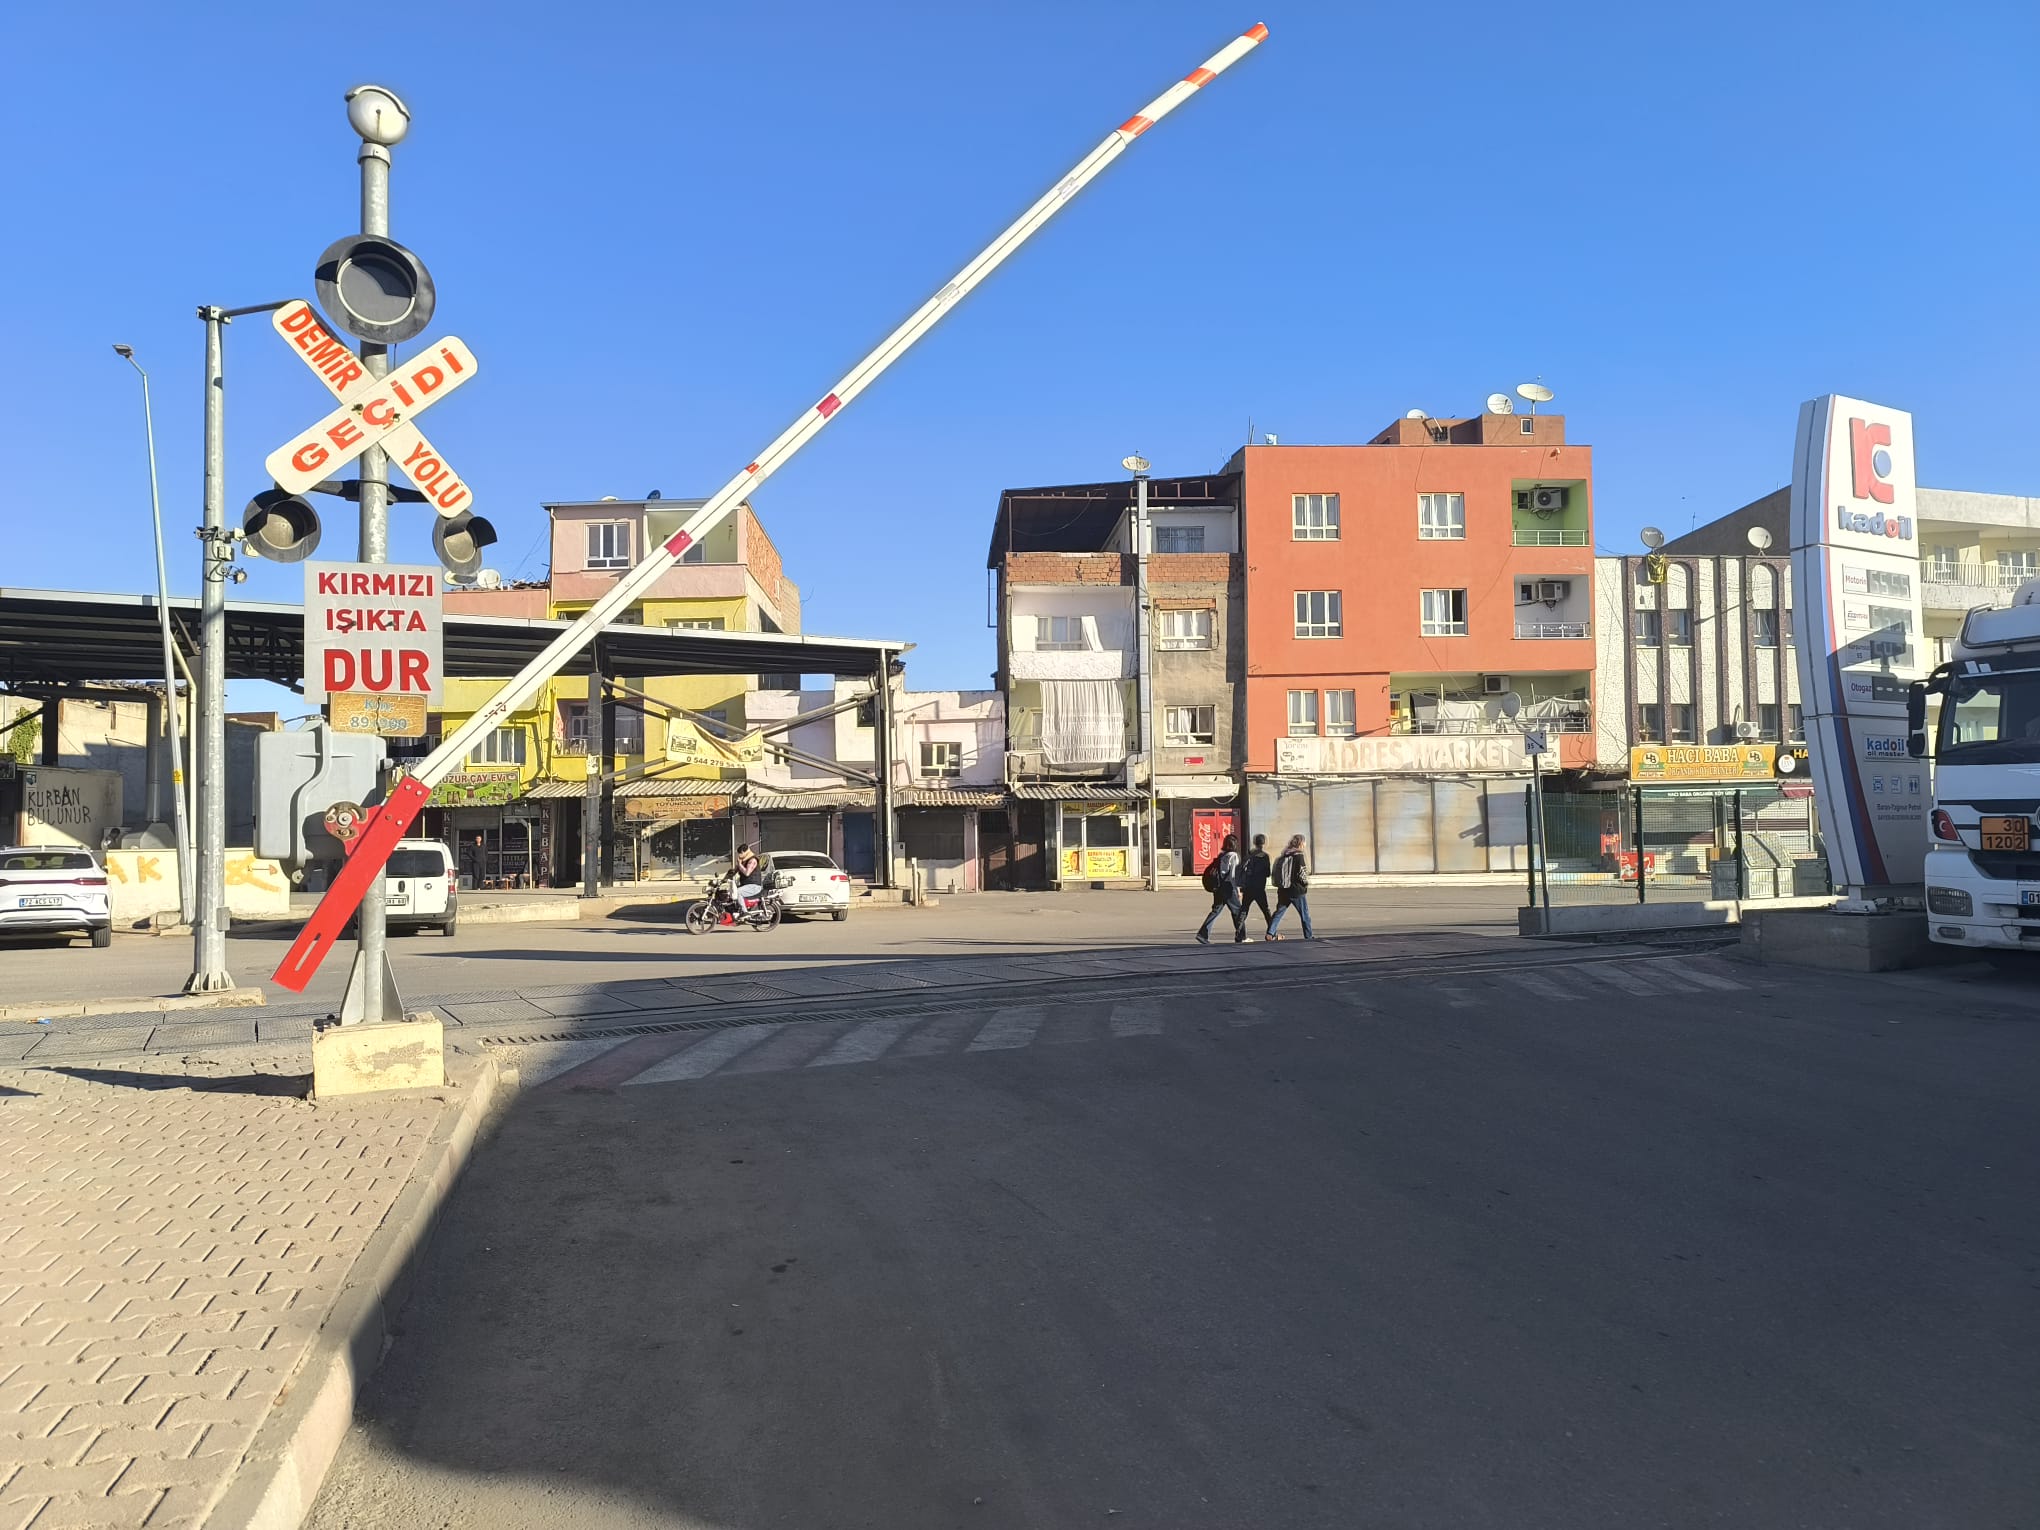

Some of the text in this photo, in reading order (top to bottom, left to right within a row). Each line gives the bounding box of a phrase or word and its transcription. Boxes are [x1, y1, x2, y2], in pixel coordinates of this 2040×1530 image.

[292, 347, 463, 473] GEÇİDİ
[1837, 505, 1912, 541] kadoil
[318, 572, 433, 597] KIRMIZI
[326, 608, 427, 634] IŞIKTA
[324, 648, 432, 692] DUR
[1851, 682, 1872, 693] Otogaz
[1412, 738, 1513, 769] MARKET
[1866, 738, 1905, 751] kadoil
[1666, 748, 1740, 763] HACI BABA
[470, 774, 488, 785] ÇAY
[28, 786, 81, 807] KURBAN
[27, 806, 92, 827] BULUNUR
[2003, 819, 2023, 833] 30
[540, 809, 549, 876] KEBAP
[1986, 835, 2024, 850] 1202
